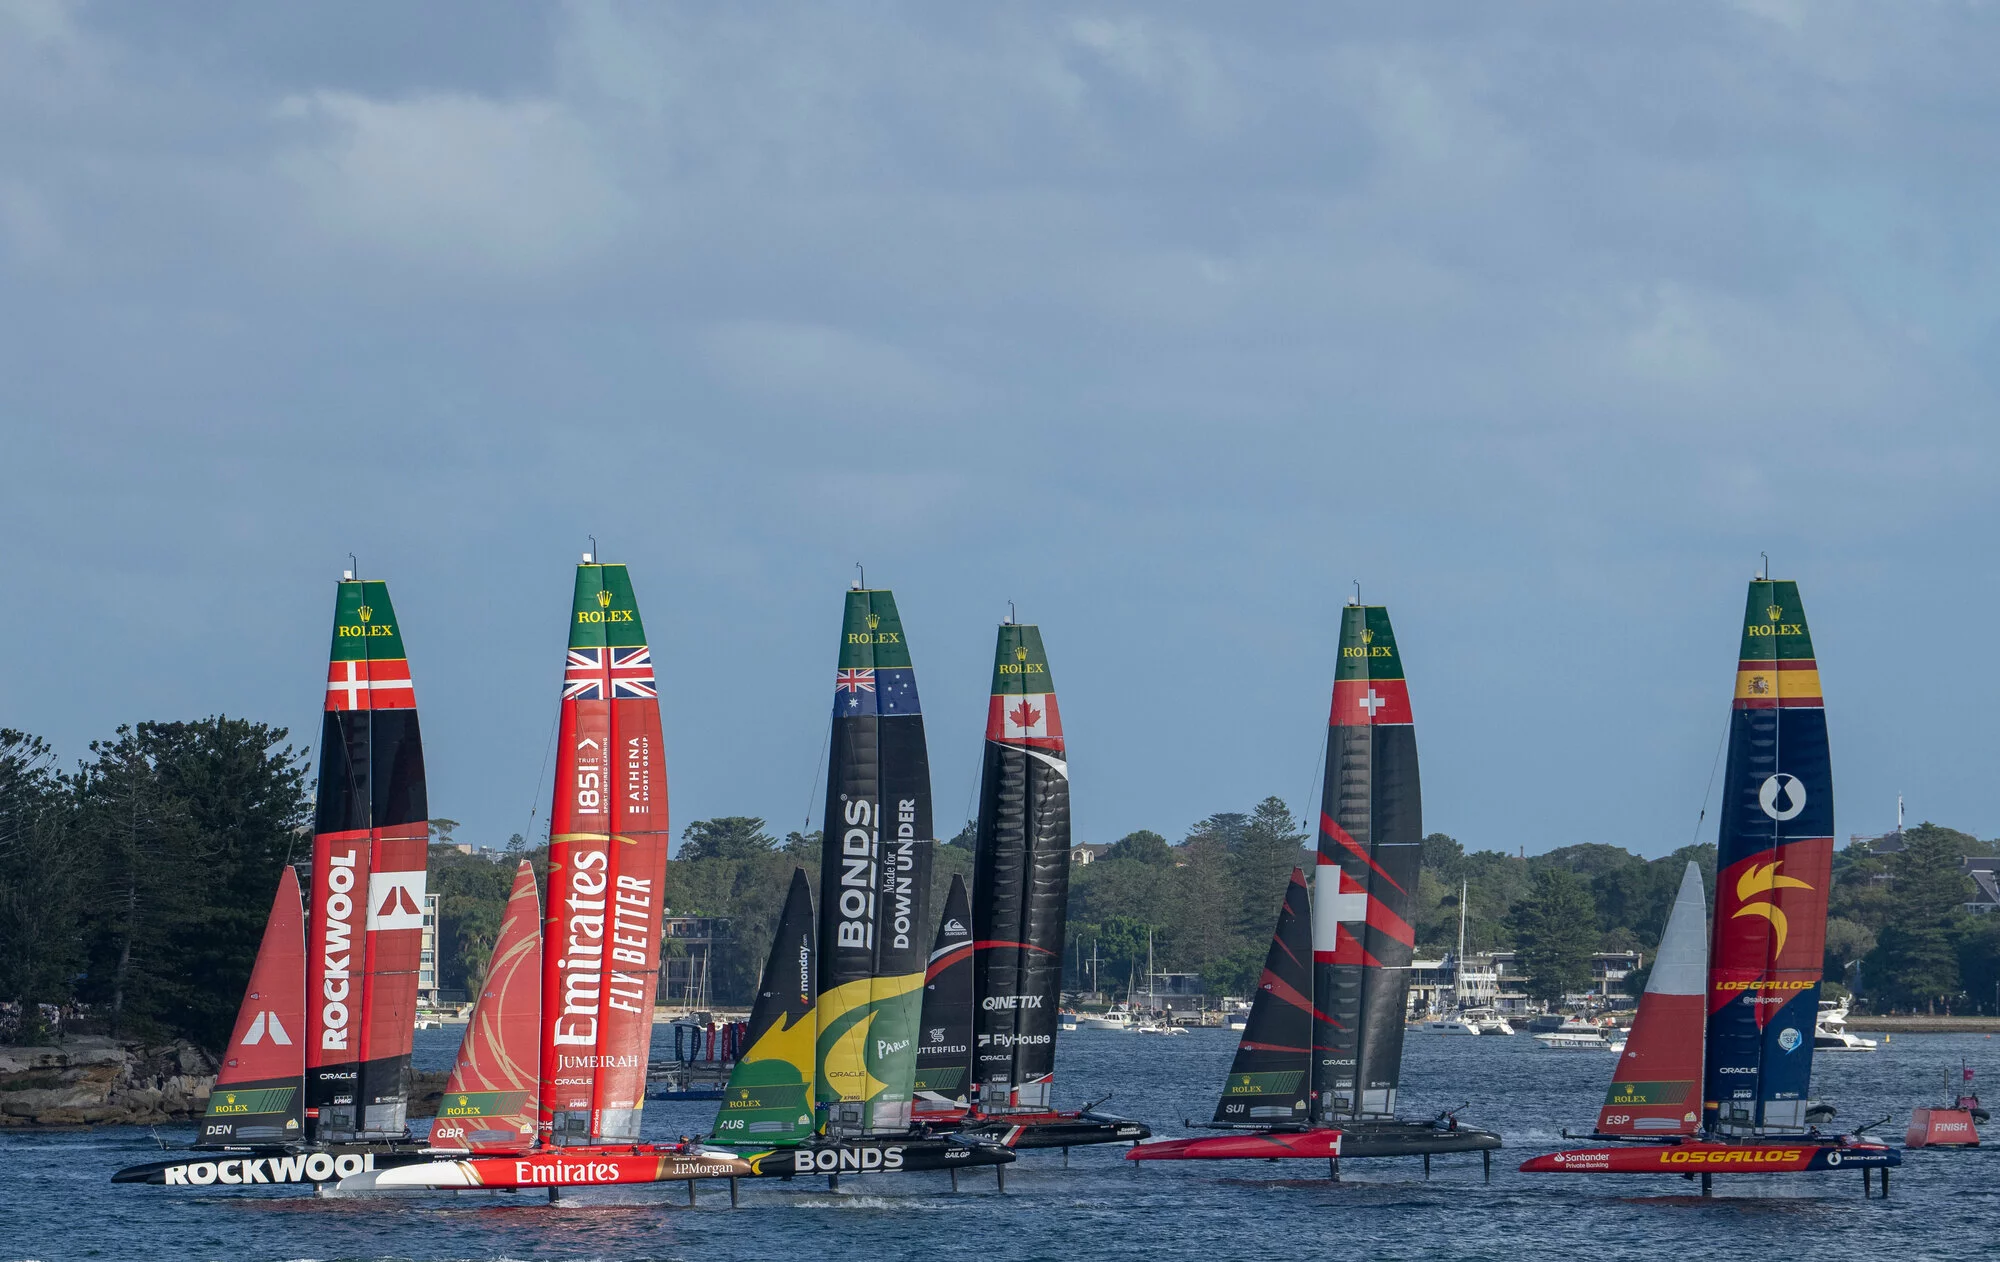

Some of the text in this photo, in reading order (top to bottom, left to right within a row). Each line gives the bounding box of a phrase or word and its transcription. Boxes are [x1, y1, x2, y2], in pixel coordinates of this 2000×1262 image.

[577, 610, 634, 623] ROLEX
[339, 625, 393, 637] ROLEX
[1748, 624, 1802, 636] ROLEX
[848, 632, 900, 644] ROLEX
[1343, 646, 1392, 657] ROLEX
[999, 663, 1044, 674] ROLEX
[628, 737, 640, 801] ATHENA
[838, 799, 871, 948] BONDS
[883, 851, 896, 894] Made for
[893, 798, 915, 949] DOWN UNDER
[322, 849, 356, 1050] ROCKWOOL
[554, 851, 608, 1046] Emirates
[609, 874, 651, 1014] FLY BETTER
[993, 1034, 1051, 1048] FlyHouse
[917, 1045, 967, 1055] UTTERFIELD
[557, 1054, 638, 1072] JUMEIRAH
[319, 1072, 358, 1080] ORACLE
[829, 1070, 865, 1078] ORACLE
[1232, 1085, 1262, 1093] ROLEX
[729, 1100, 761, 1108] ROLEX
[1614, 1095, 1647, 1103] ROLEX
[215, 1104, 248, 1113] ROLEX
[447, 1107, 481, 1115] ROLEX
[1225, 1104, 1245, 1113] SUI
[720, 1119, 745, 1130] AUS
[1606, 1115, 1630, 1125] ESP
[206, 1124, 232, 1135] DEN
[1935, 1122, 1968, 1132] FINISH
[436, 1128, 464, 1138] GBR
[794, 1147, 904, 1171] BONDS
[1565, 1152, 1610, 1162] Santander
[164, 1153, 374, 1185] ROCKWOOL
[515, 1160, 620, 1183] Emirates
[672, 1163, 733, 1177] J.P.Morgan
